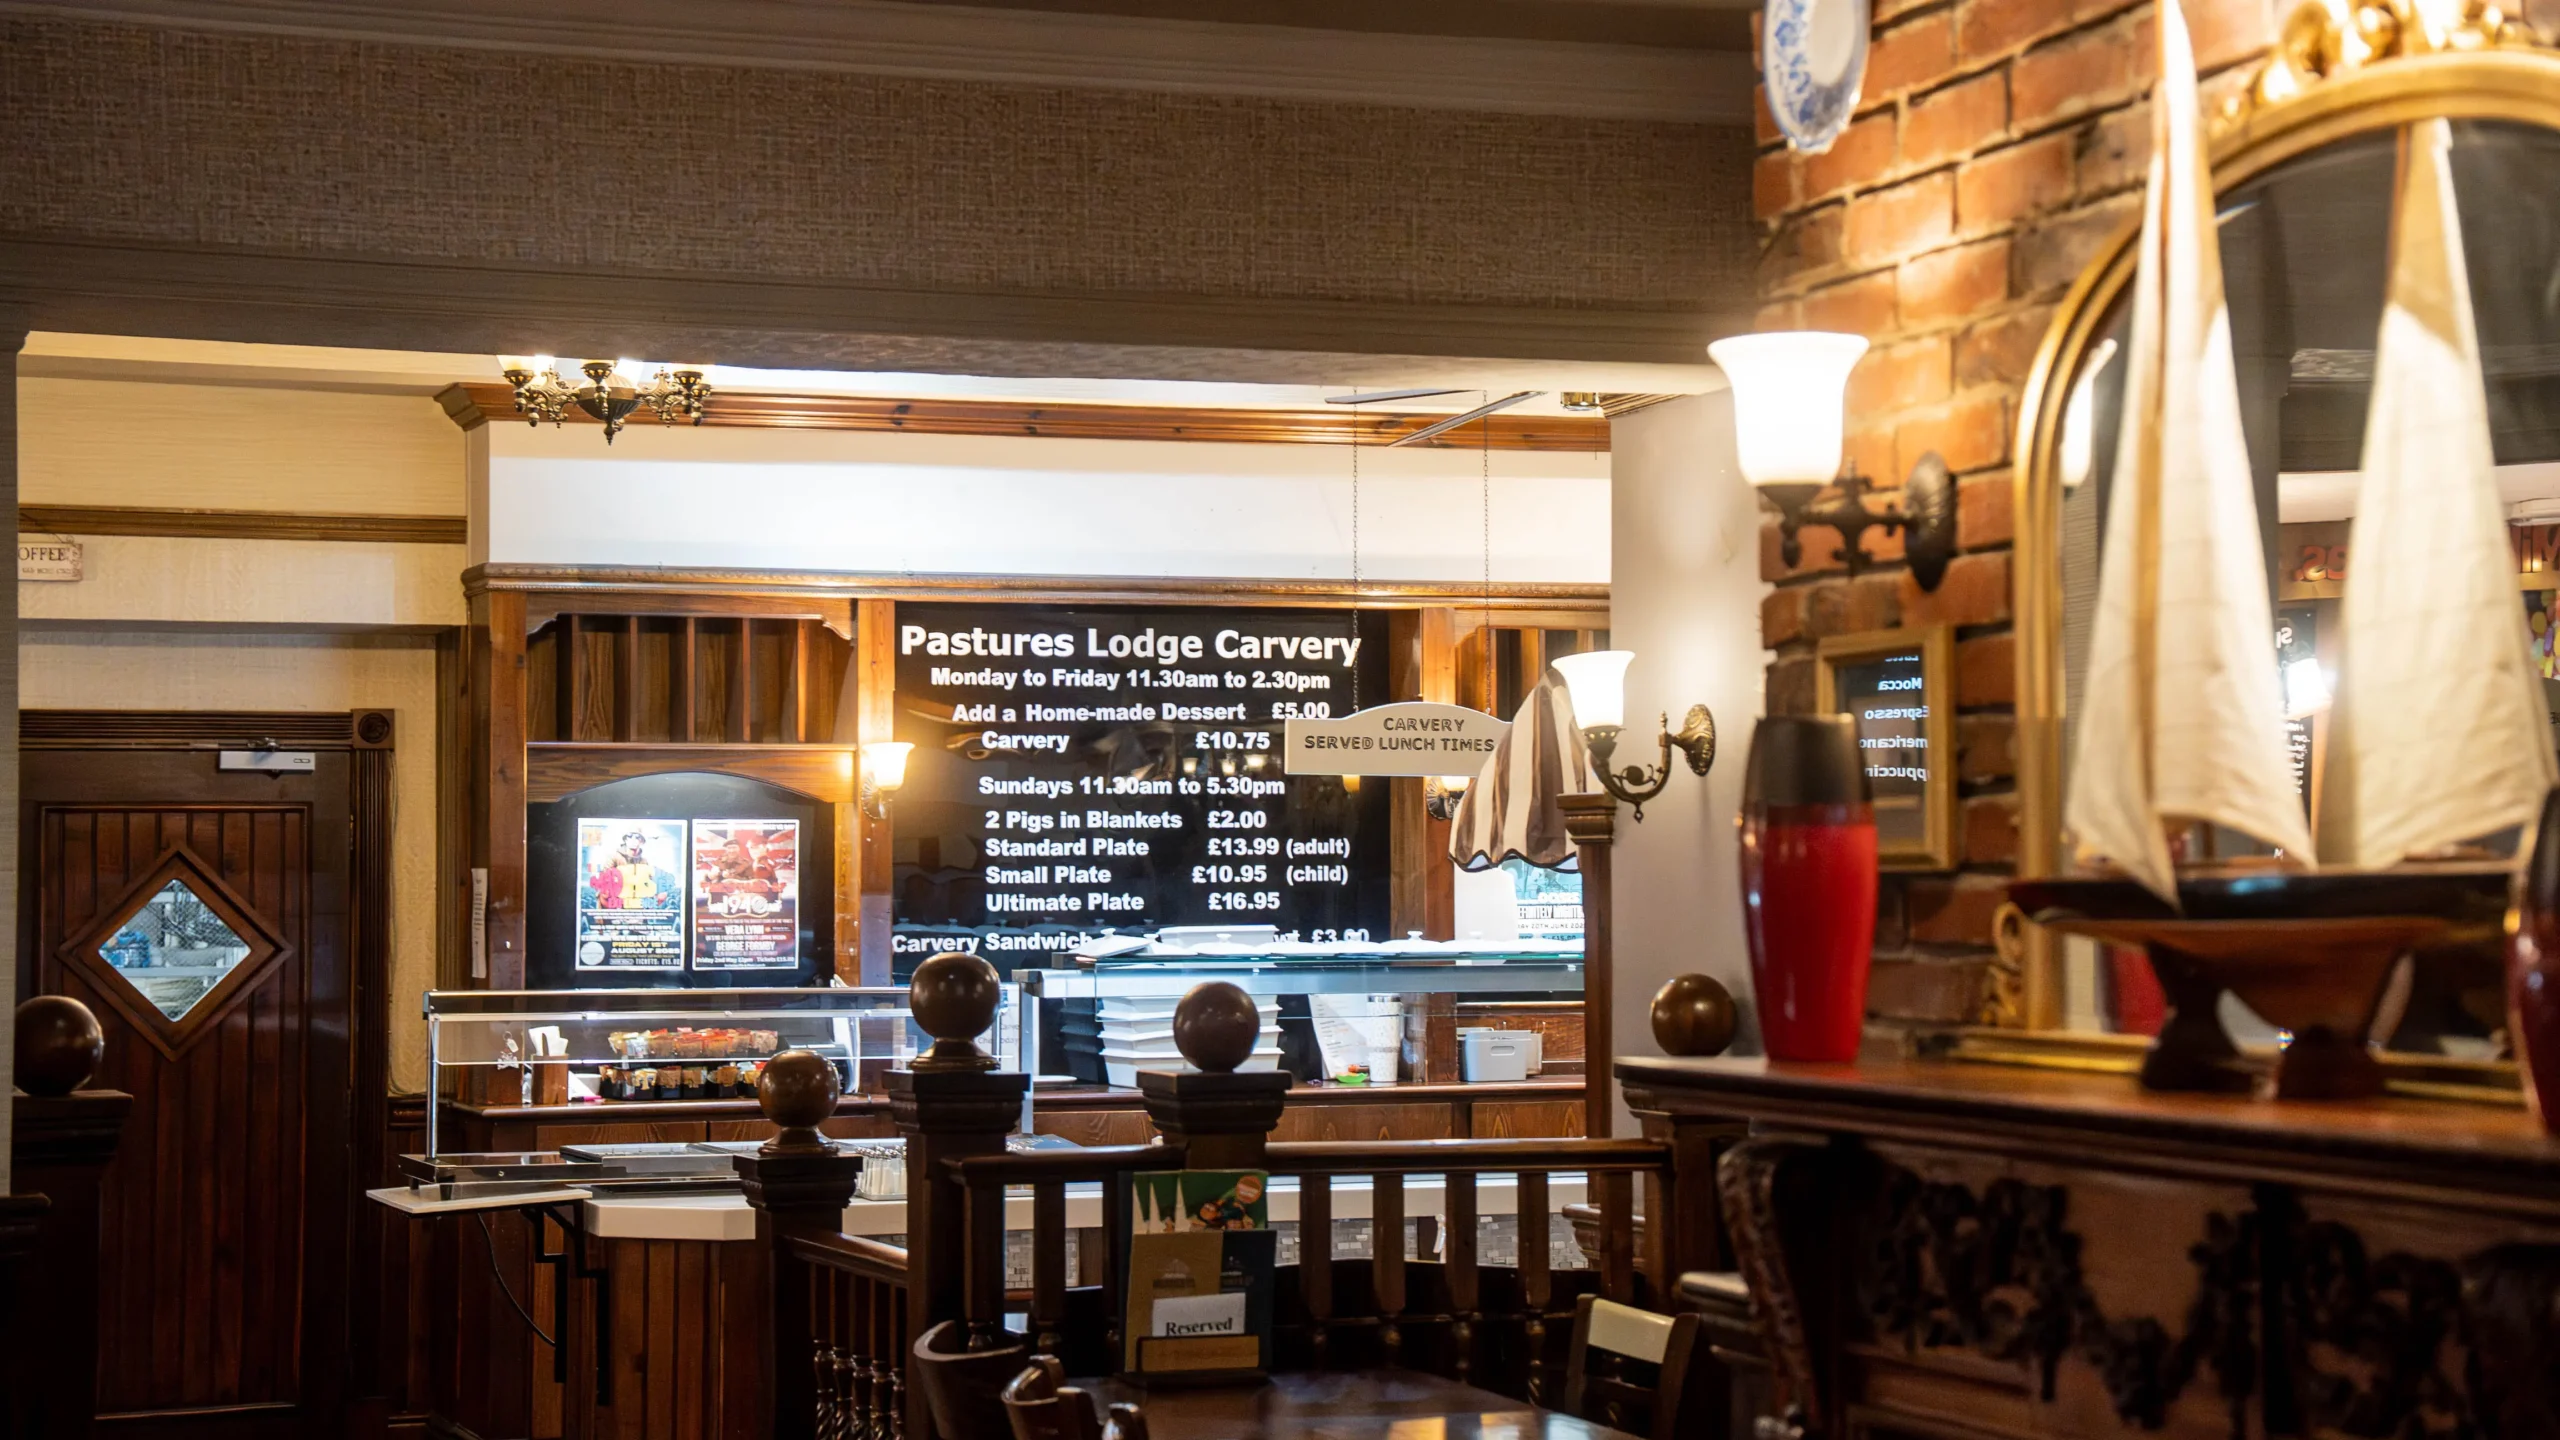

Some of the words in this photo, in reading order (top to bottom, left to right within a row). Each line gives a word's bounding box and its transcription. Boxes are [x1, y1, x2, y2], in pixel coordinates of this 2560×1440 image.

[19, 546, 70, 561] OFFEE
[902, 625, 1074, 657] Pastures
[1087, 627, 1203, 665] Lodge
[1214, 628, 1362, 668] Carvery
[930, 667, 1018, 691] Monday
[1022, 668, 1047, 687] to
[1052, 668, 1121, 691] Friday
[1126, 669, 1218, 688] 11.30am
[1223, 670, 1247, 689] to
[1251, 670, 1331, 693] 2.30pm
[951, 703, 997, 722] Add
[1002, 708, 1017, 722] a
[1025, 703, 1156, 722] Home-made
[1161, 702, 1246, 721] Dessert
[1271, 701, 1331, 720] £5.00
[1383, 717, 1465, 732] CARVERY
[981, 730, 1070, 753] Carvery
[1195, 731, 1271, 750] £10.75
[1304, 735, 1374, 750] SERVED
[1379, 737, 1435, 751] LUNCH
[1440, 738, 1495, 752] TIMES
[978, 776, 1074, 798] Sundays
[1079, 776, 1173, 795] 11.30am
[1178, 777, 1202, 795] to
[1206, 776, 1286, 798] 5.30pm
[984, 810, 1000, 829] 2
[1006, 810, 1055, 833] Pigs
[1060, 810, 1081, 829] in
[1086, 810, 1183, 829] Blankets
[1207, 810, 1267, 829] £2.00
[985, 838, 1087, 857] Standard
[1092, 837, 1150, 856] Plate
[1207, 837, 1280, 856] £13.99
[1286, 837, 1351, 859] (adult)
[985, 865, 1048, 884] Small
[1054, 865, 1112, 884] Plate
[1191, 864, 1268, 884] £10.95
[1286, 864, 1349, 886] (child)
[986, 893, 1082, 912] Ultimate
[1087, 892, 1145, 911] Plate
[1208, 891, 1281, 911] £16.95
[891, 934, 980, 955] Carvery
[1165, 1317, 1233, 1337] Reserved
